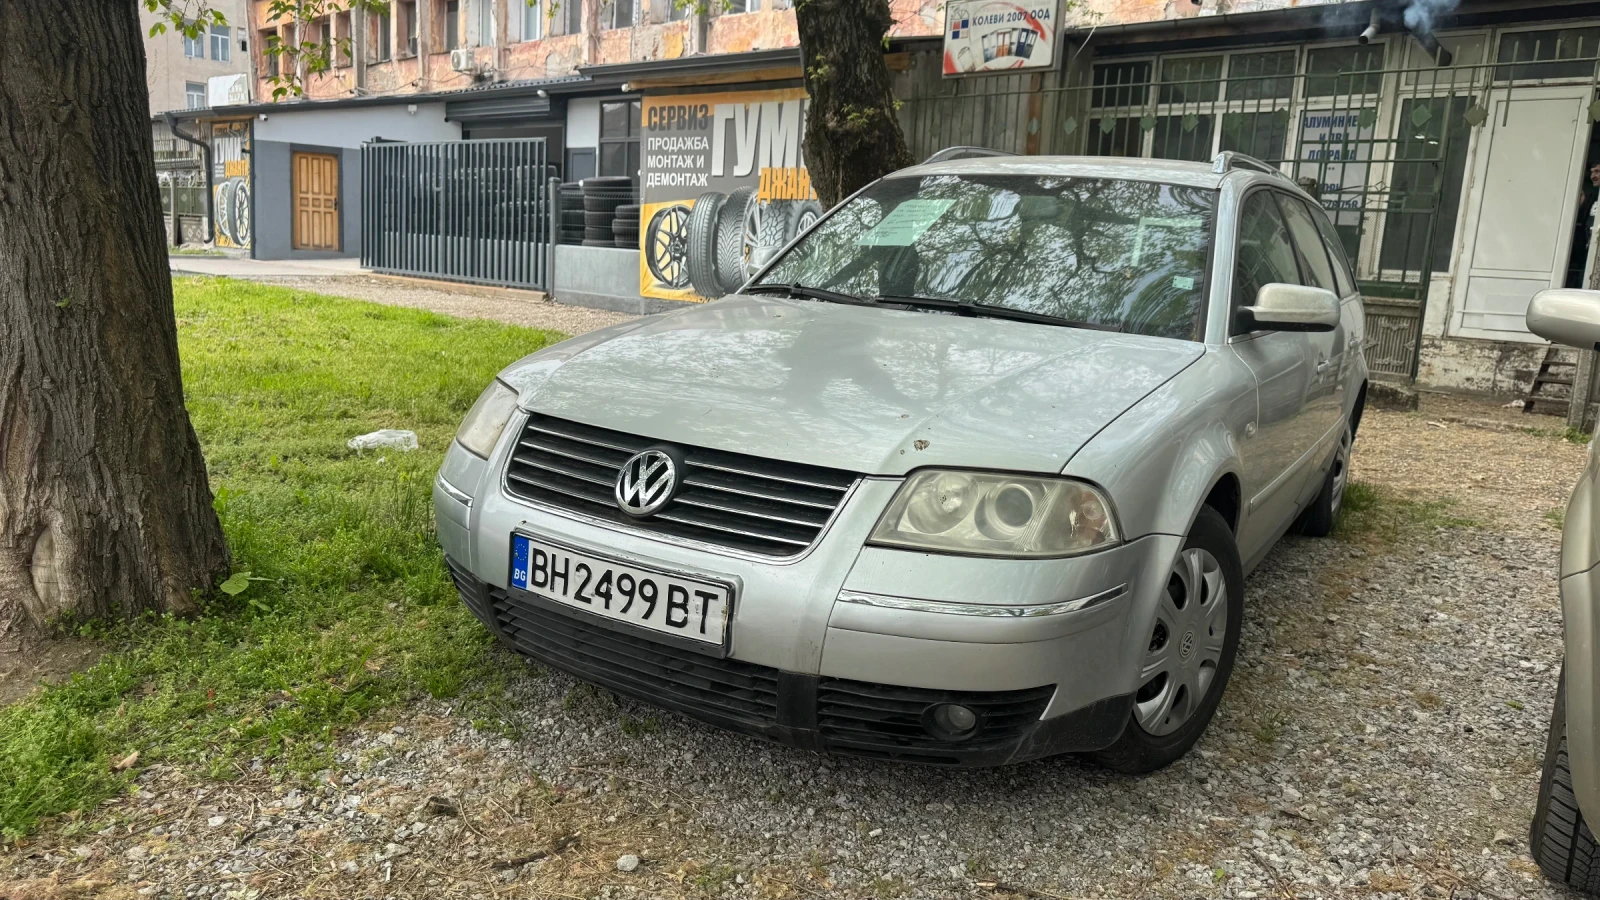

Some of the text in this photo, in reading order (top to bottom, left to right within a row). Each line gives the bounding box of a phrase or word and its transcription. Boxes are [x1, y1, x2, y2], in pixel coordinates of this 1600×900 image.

[972, 8, 1050, 27] КОЛЕВИ 2007 ООД
[648, 104, 709, 131] СЕРВИЗ
[648, 136, 709, 152] ПРОДАЖБА
[647, 155, 704, 168] МОНТАЖ И
[646, 172, 708, 188] ДЕМОНТАЖ
[757, 167, 818, 205] ДЖАН
[514, 568, 526, 582] BG
